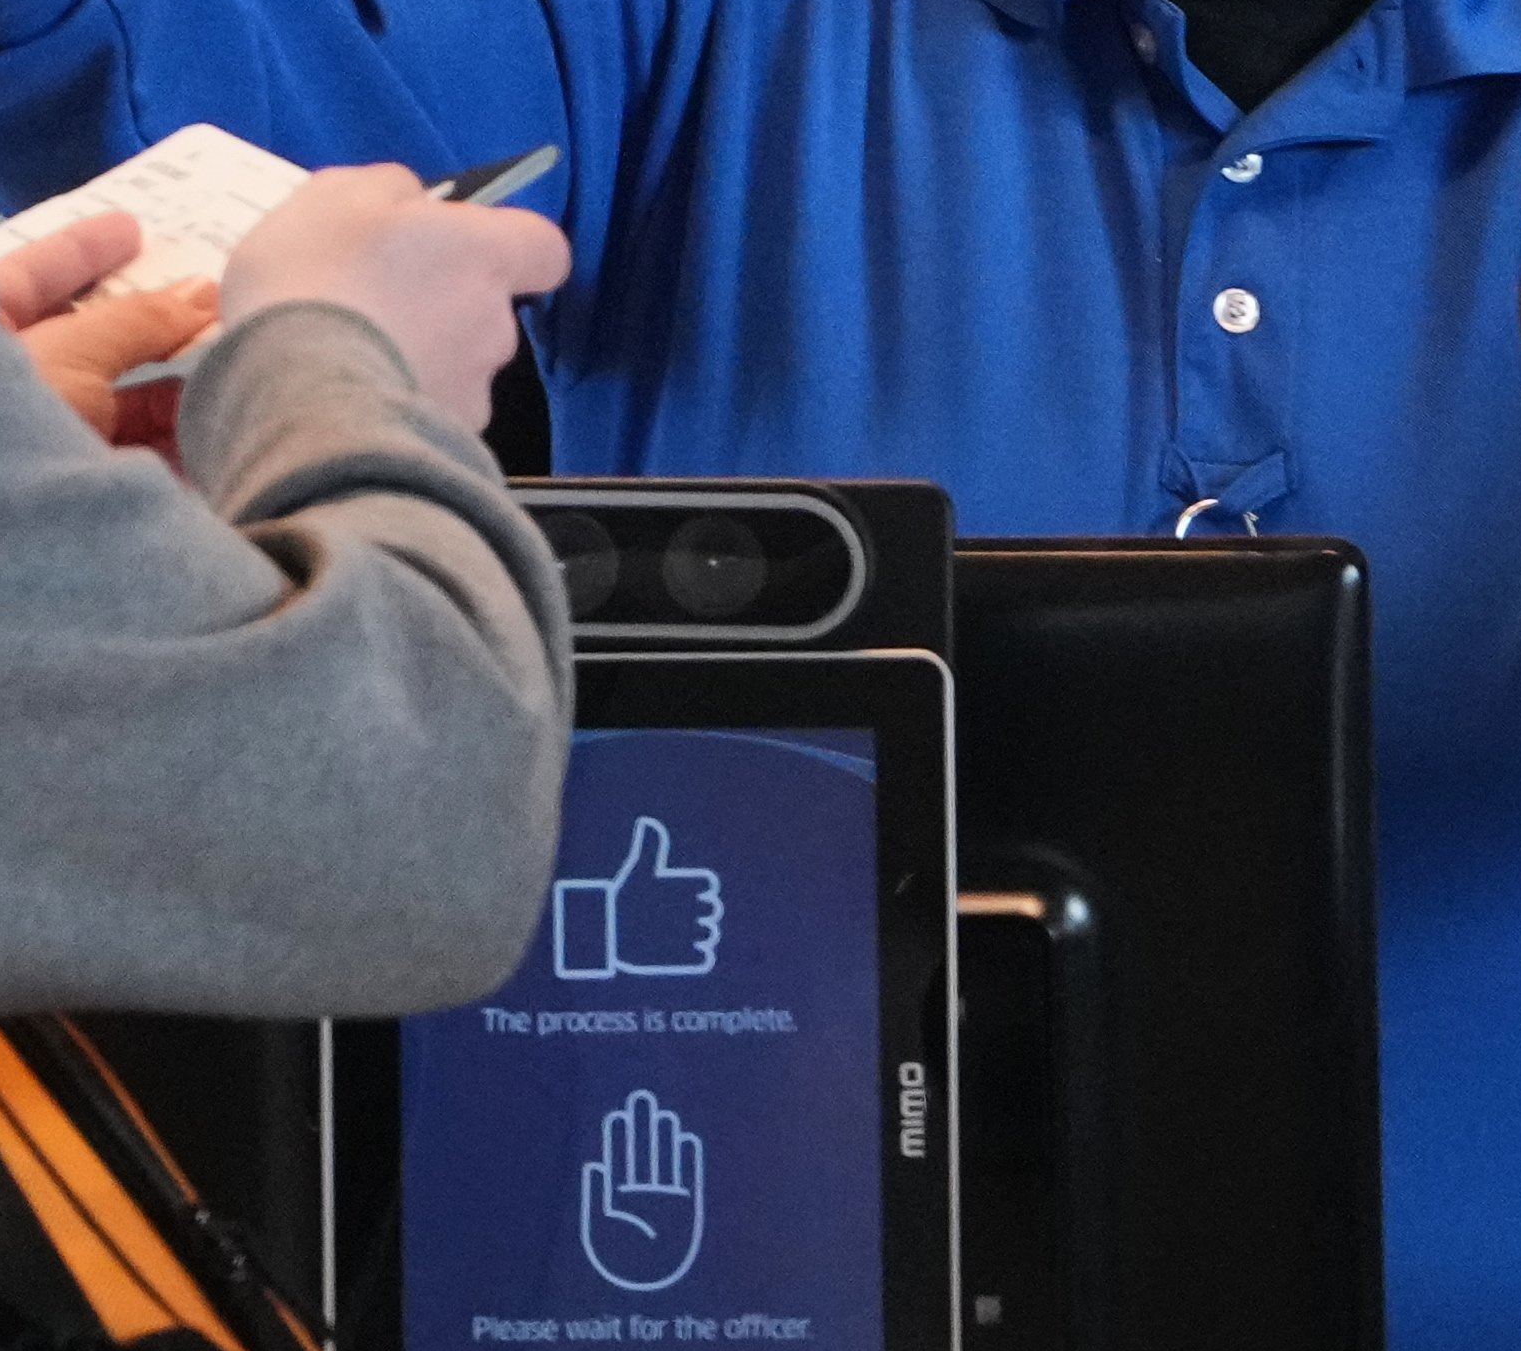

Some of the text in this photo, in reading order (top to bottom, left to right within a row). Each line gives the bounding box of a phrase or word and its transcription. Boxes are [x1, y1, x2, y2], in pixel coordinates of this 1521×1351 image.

[481, 1006, 798, 1036] The process is complete.
[898, 1060, 926, 1159] mimo
[472, 1315, 559, 1341] Please
[565, 1314, 623, 1341] wait
[628, 1313, 670, 1341] for
[672, 1314, 718, 1341] the
